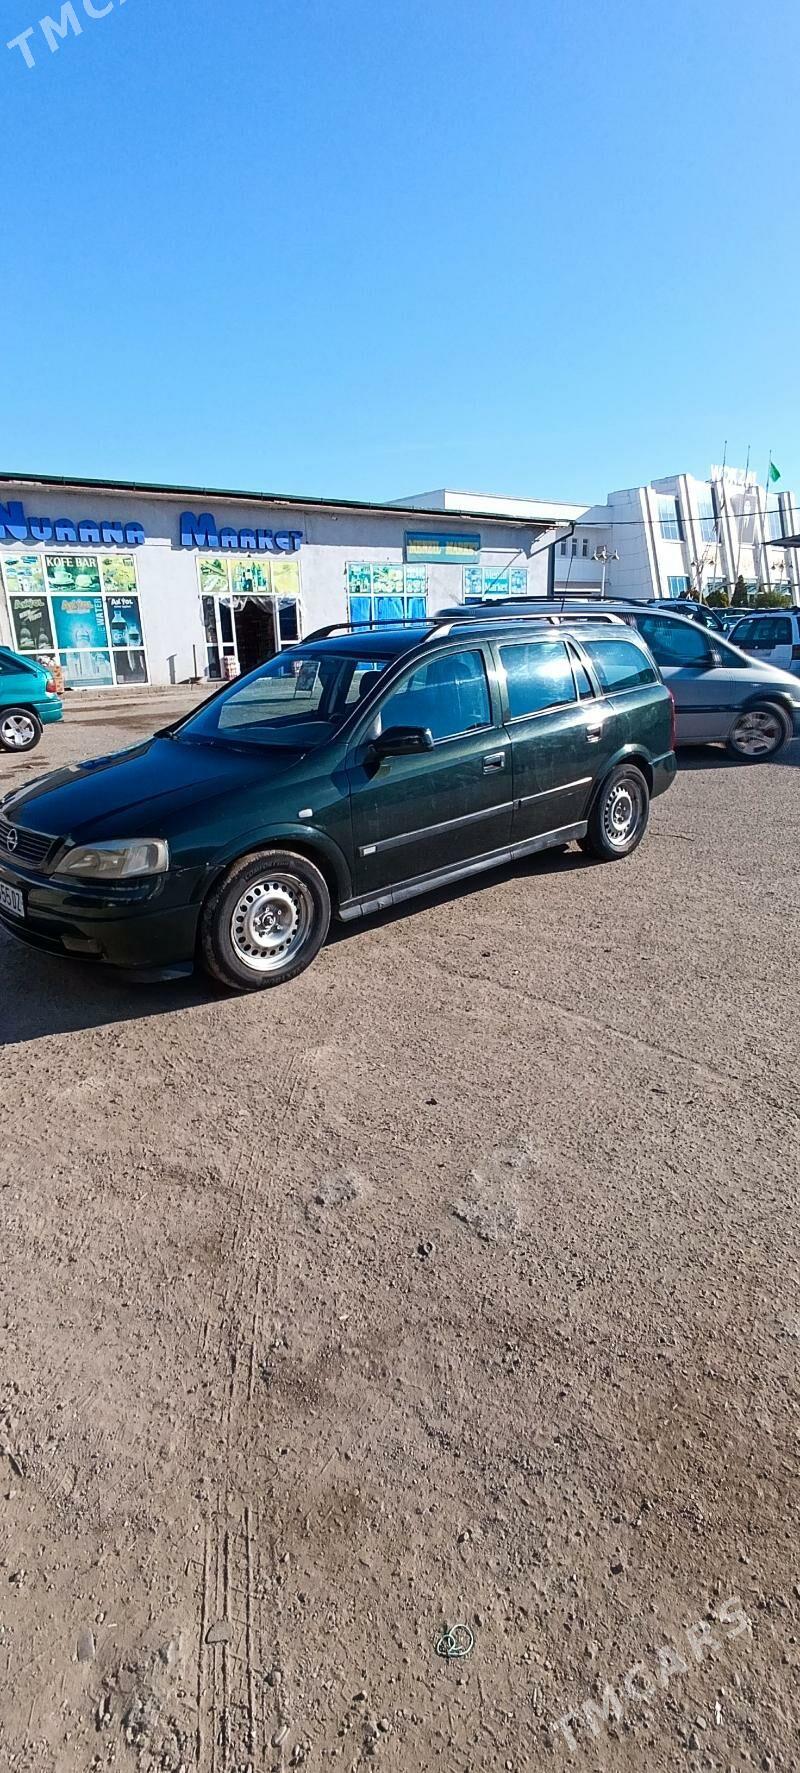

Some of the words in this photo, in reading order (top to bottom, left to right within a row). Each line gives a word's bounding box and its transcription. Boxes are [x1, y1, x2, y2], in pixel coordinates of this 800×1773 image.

[46, 556, 74, 567] KOFE
[75, 557, 96, 568] BAR
[94, 598, 105, 626] WATER
